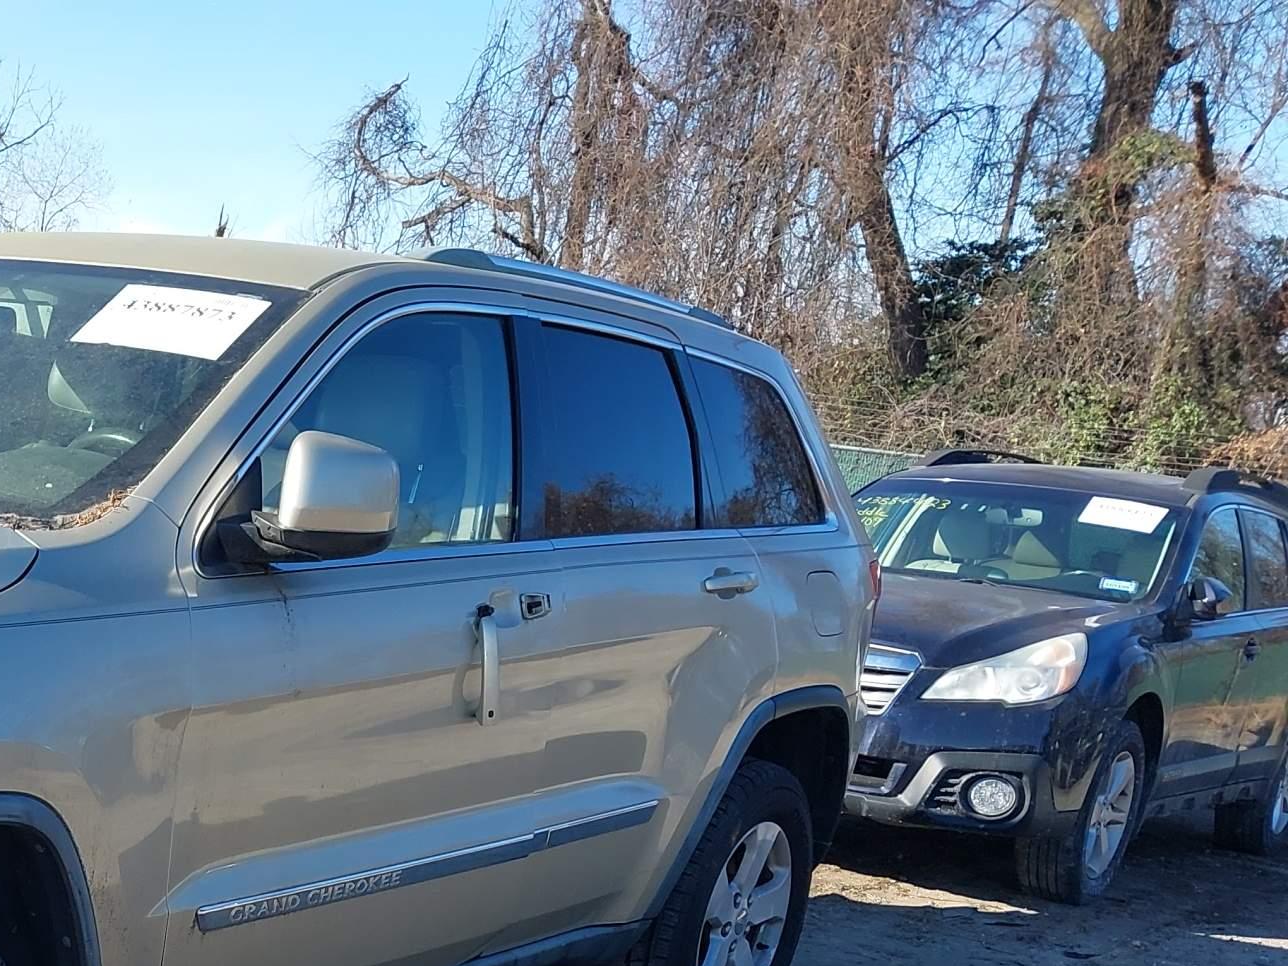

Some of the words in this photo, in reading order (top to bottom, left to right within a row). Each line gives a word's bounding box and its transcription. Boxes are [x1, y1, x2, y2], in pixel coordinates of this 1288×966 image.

[122, 299, 240, 322] 43887873
[230, 894, 301, 922] GRAND
[308, 870, 403, 906] CHEROKEE
